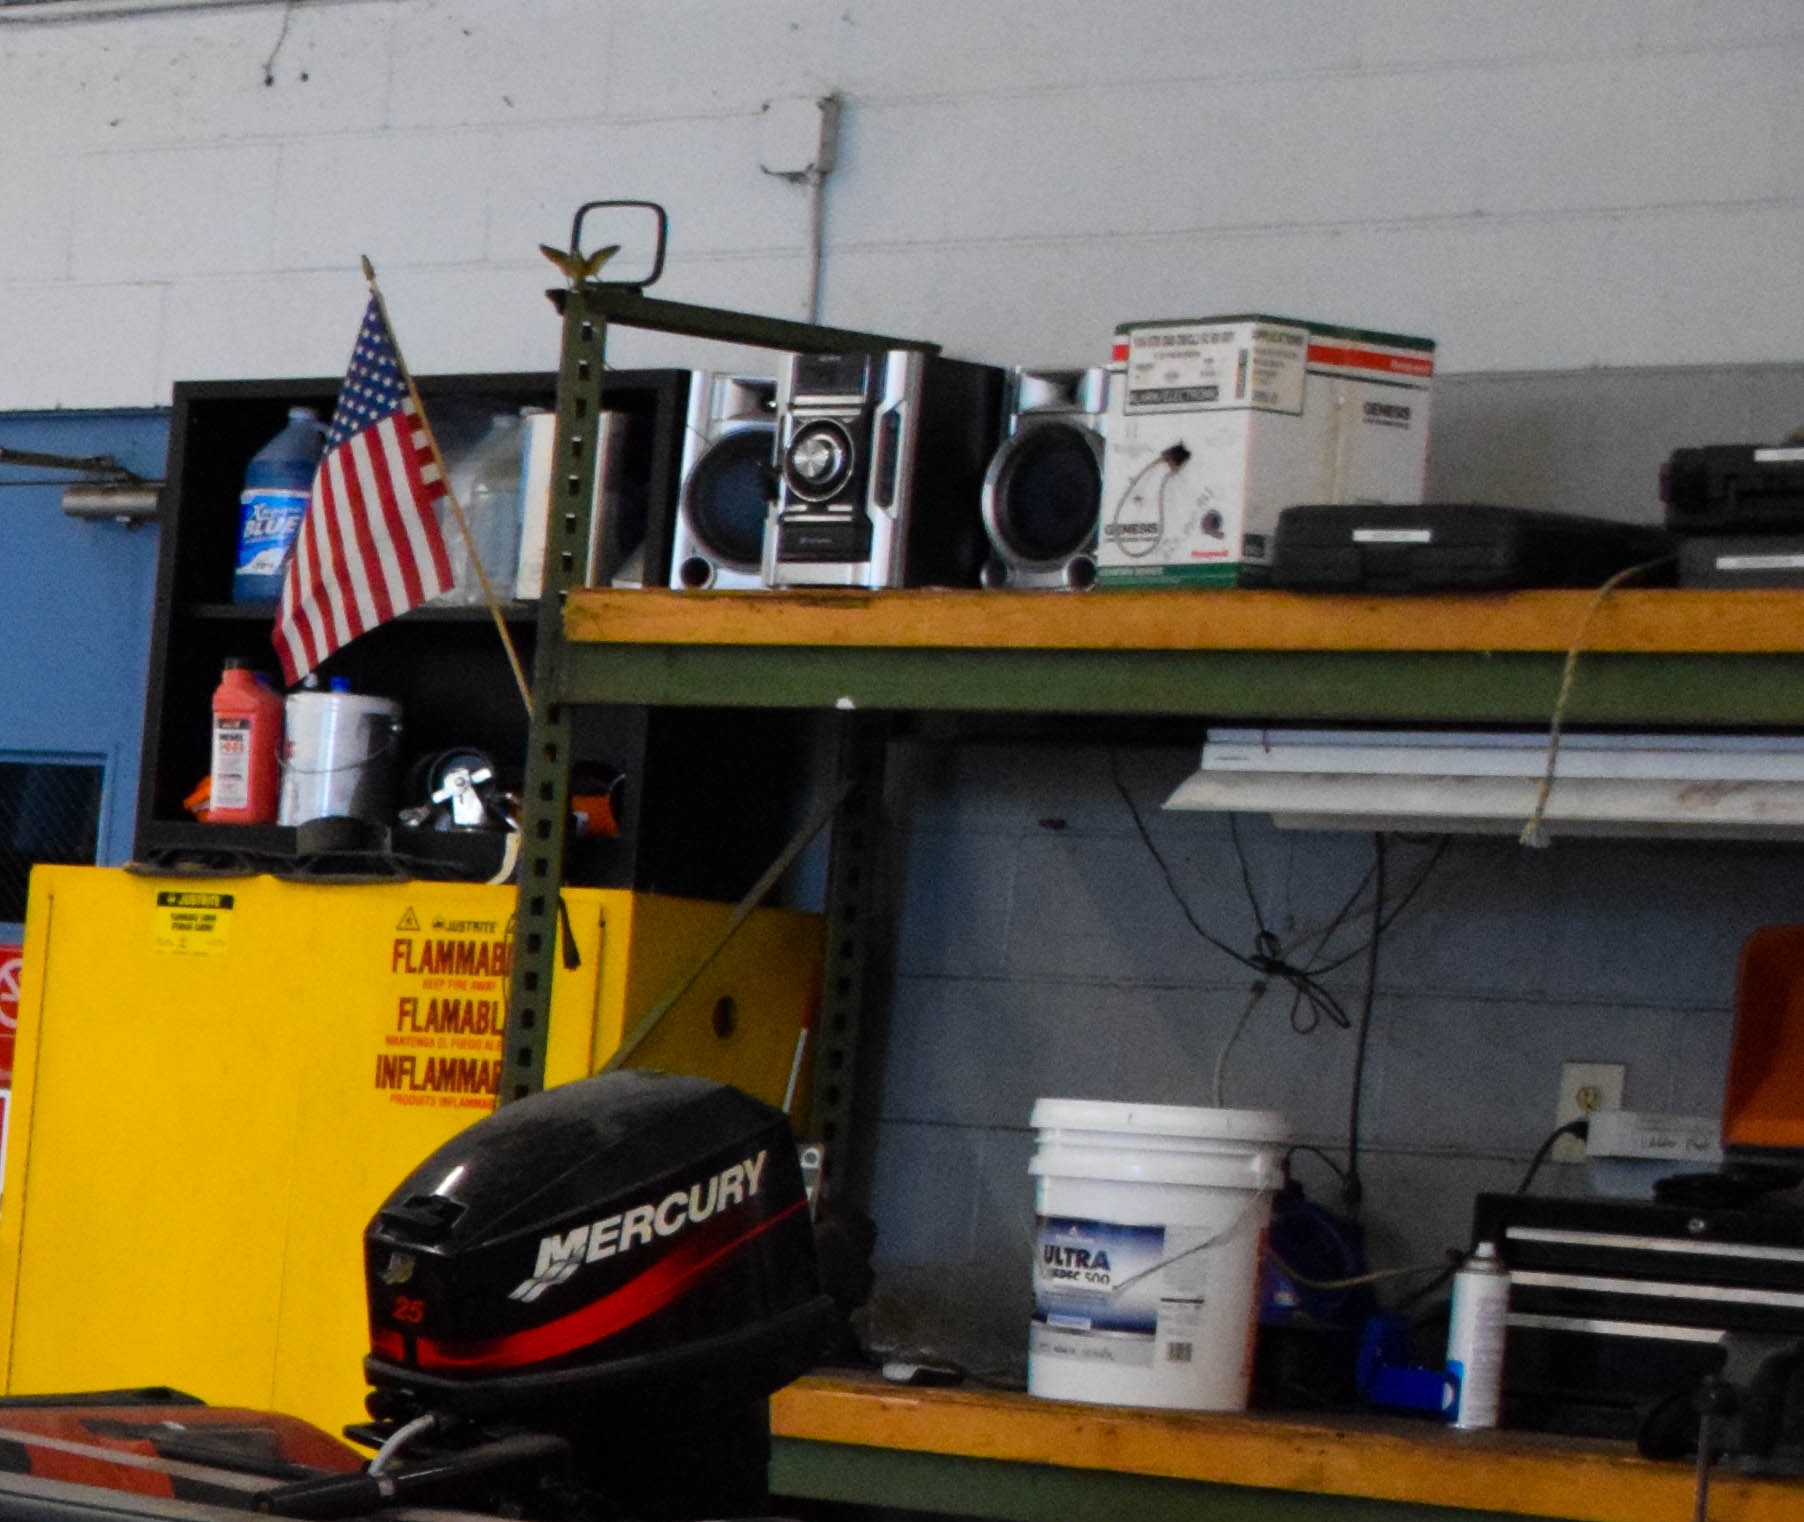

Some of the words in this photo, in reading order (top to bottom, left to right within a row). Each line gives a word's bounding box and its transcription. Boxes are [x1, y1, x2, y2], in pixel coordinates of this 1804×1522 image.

[522, 1150, 768, 1290] MERCURY
[1043, 1244, 1112, 1272] ULTRA
[391, 1296, 425, 1324] 25
